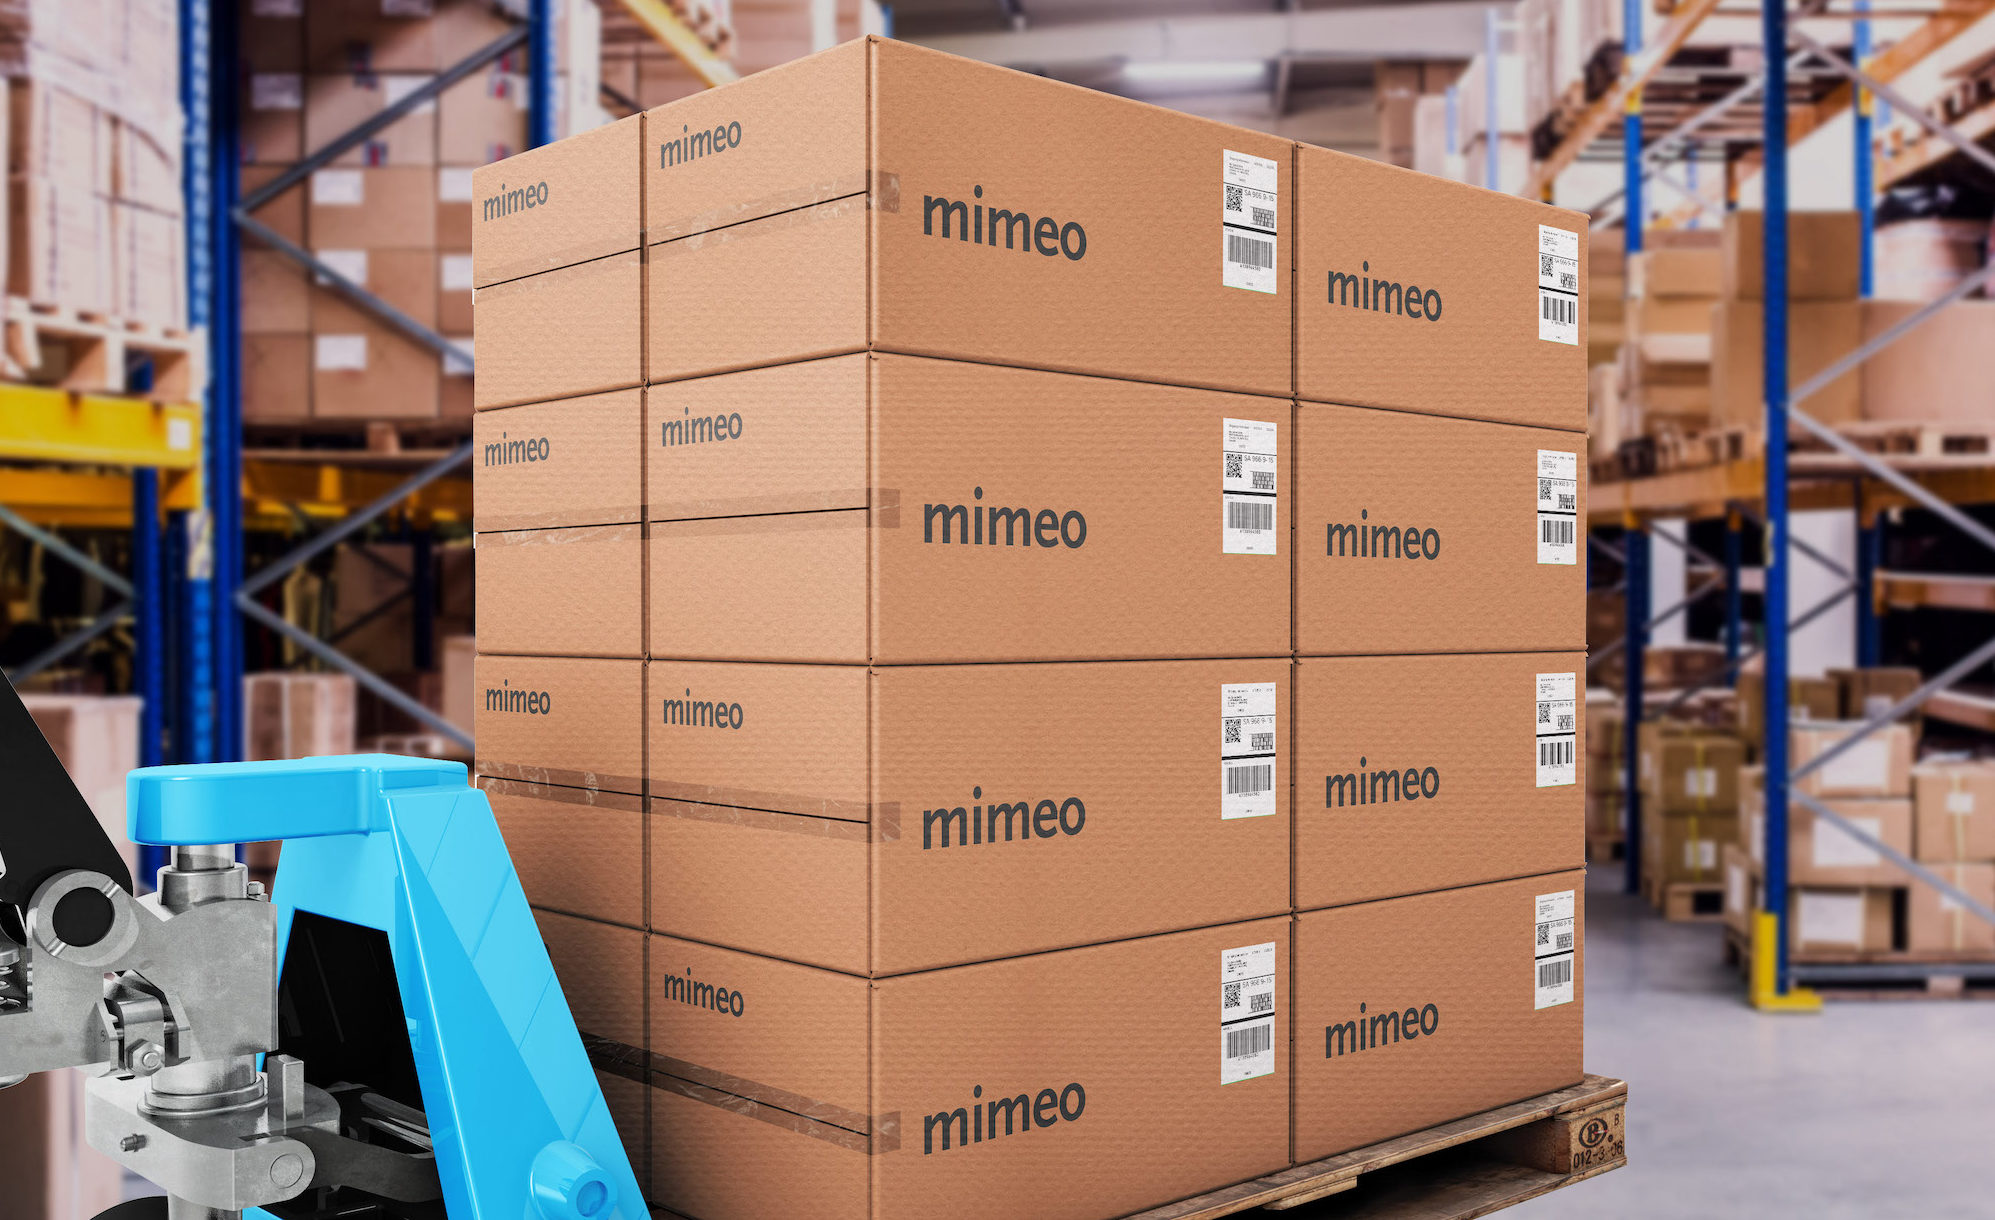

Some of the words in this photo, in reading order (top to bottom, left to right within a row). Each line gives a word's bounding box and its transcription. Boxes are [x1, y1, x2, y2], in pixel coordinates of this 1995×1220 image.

[662, 121, 742, 169] mimeo
[484, 181, 548, 221] mimeo
[924, 184, 1086, 261] mimeo
[1328, 260, 1442, 322] mimeo
[485, 432, 549, 467] mimeo
[662, 406, 742, 447] mimeo
[924, 486, 1086, 549] mimeo
[1327, 508, 1440, 561] mimeo
[486, 680, 550, 715] mimeo
[664, 687, 743, 730] mimeo
[1326, 756, 1439, 809] mimeo
[922, 785, 1085, 850] mimeo
[664, 967, 743, 1018] mimeo
[1326, 1001, 1438, 1059] mimeo
[923, 1082, 1086, 1155] mimeo
